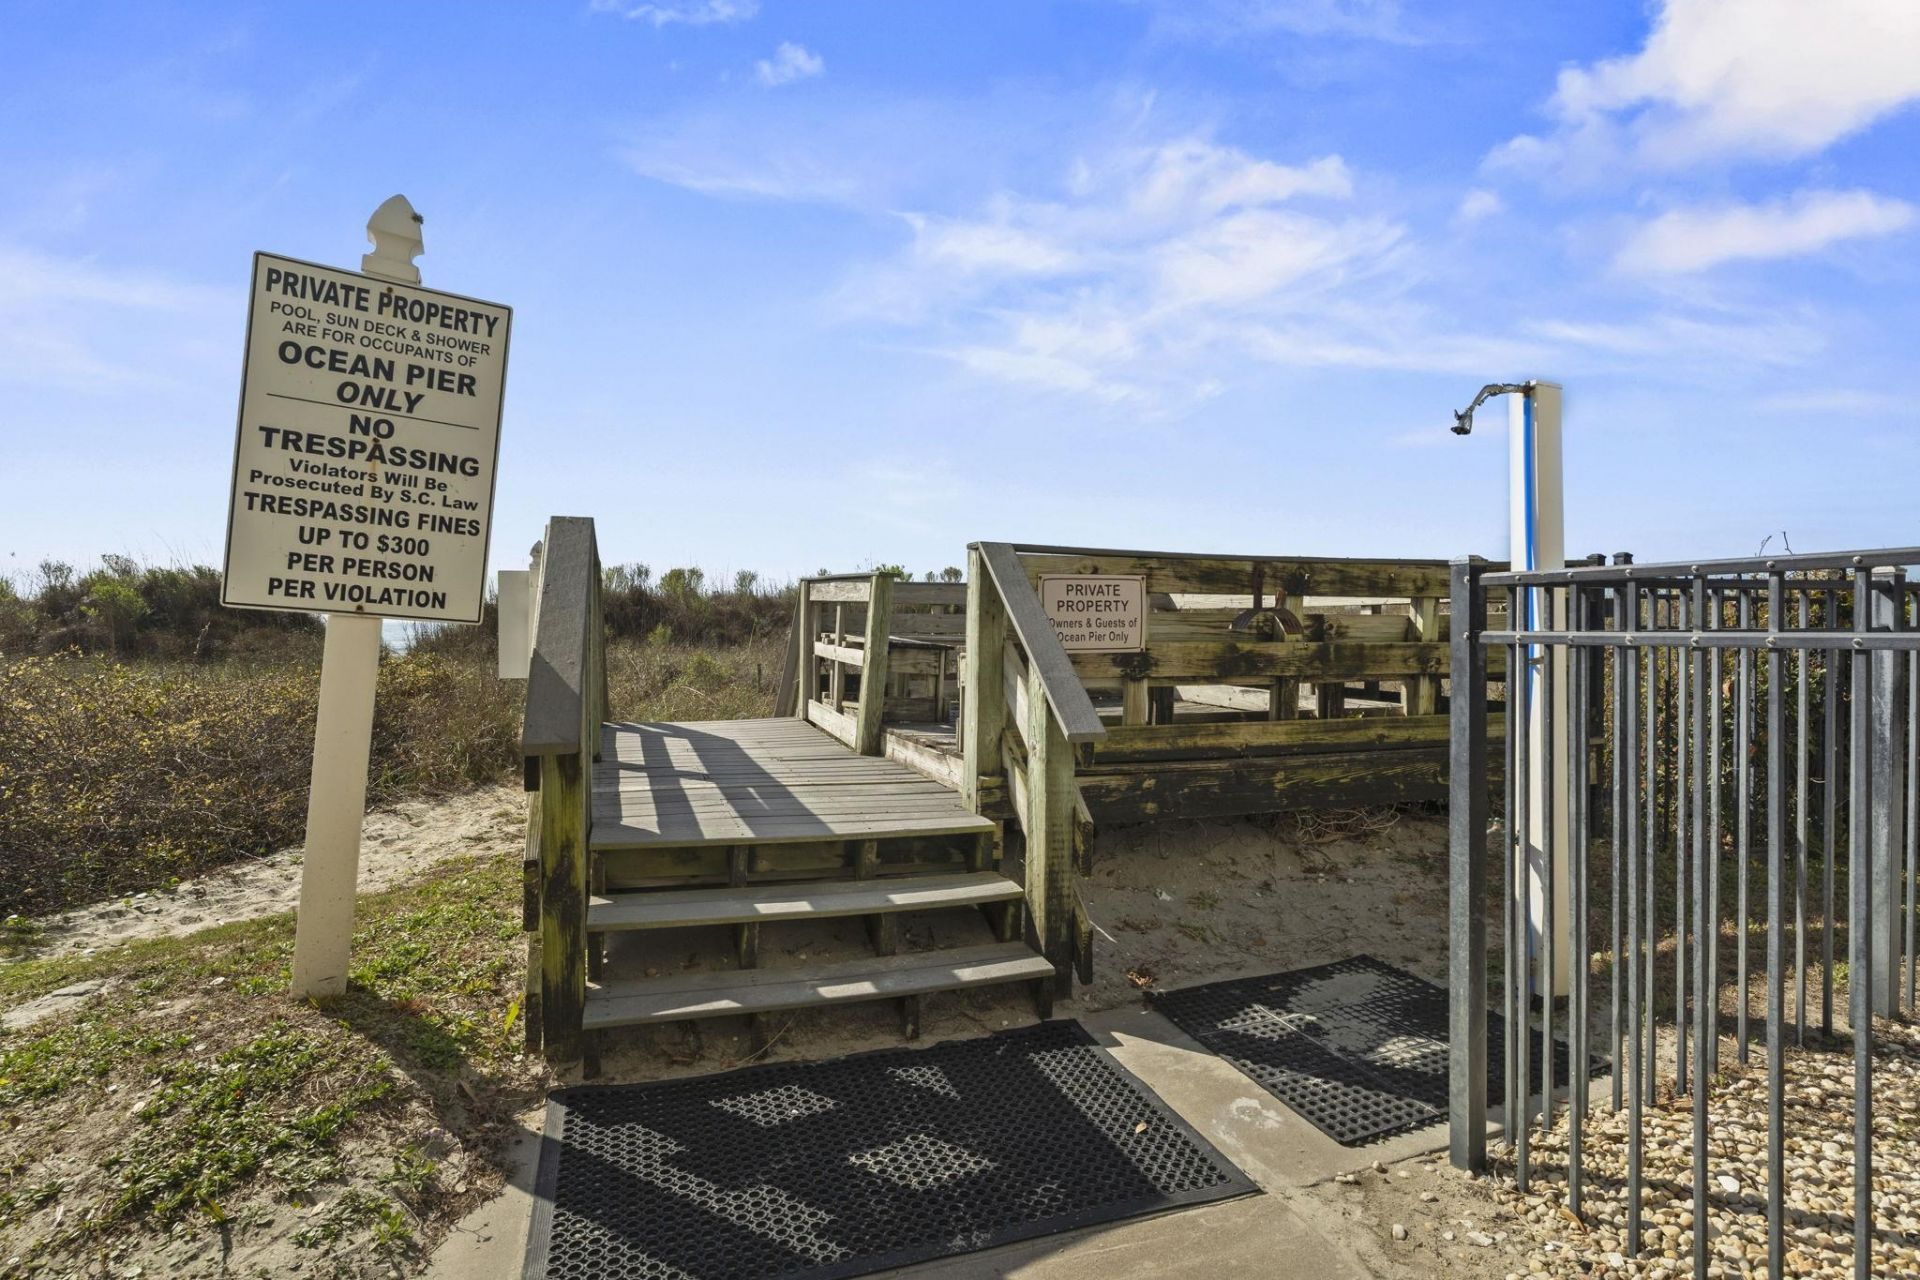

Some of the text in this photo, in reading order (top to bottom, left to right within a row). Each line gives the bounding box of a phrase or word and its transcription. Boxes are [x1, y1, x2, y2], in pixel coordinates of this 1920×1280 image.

[265, 267, 499, 338] PRIVATE PROPERTY
[270, 301, 490, 356] POOL, SUN DECK & SHOWER
[282, 321, 478, 367] ARE FOR OCCUPANTS OF
[278, 341, 476, 396] OCEAN PIER
[336, 381, 425, 414] ONLY
[349, 414, 395, 439] NO
[259, 426, 479, 476] TRESPASSING
[250, 470, 478, 511] Prosecuted By S.C. Law
[289, 458, 448, 492] Violators Will Be
[243, 492, 480, 536] TRESPASSING FINES
[299, 526, 429, 556] UP TO $300
[287, 552, 434, 582] PER PERSON
[268, 578, 446, 609] PER VIOLATION
[1057, 600, 1129, 612] PROPERTY
[1066, 584, 1120, 596] PRIVATE
[1049, 618, 1138, 628] Owners & Guests of
[1057, 632, 1128, 643] Ocean Pier Only
